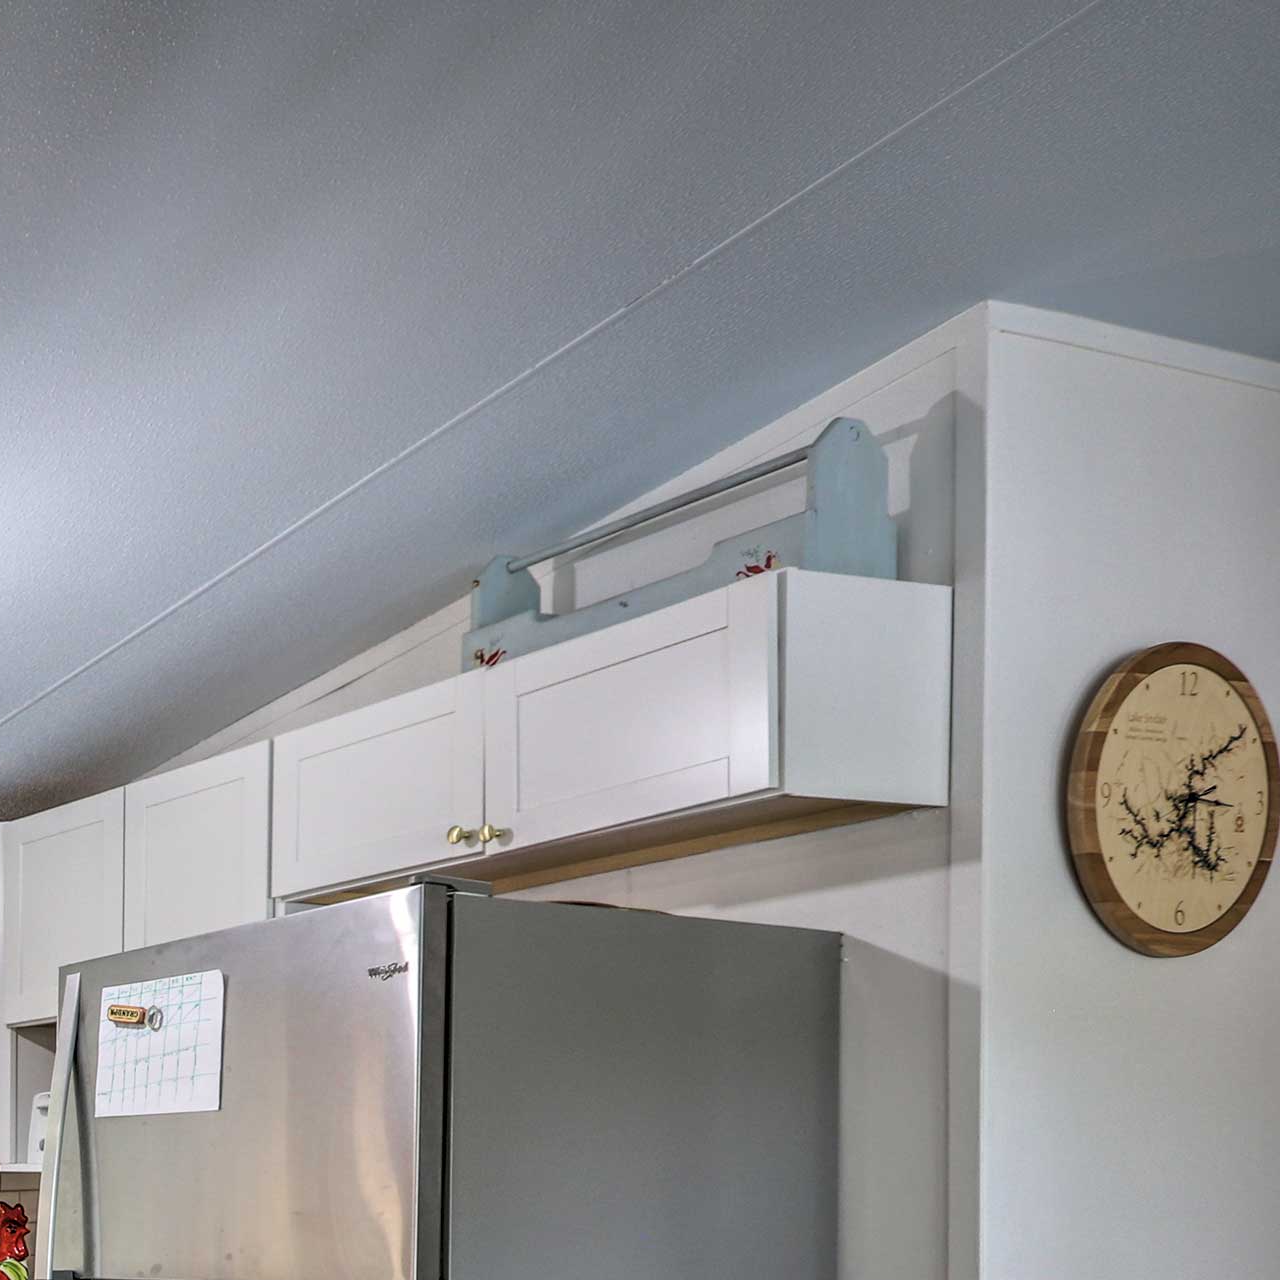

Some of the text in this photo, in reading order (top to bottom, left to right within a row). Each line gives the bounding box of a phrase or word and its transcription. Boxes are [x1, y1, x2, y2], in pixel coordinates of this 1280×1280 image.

[1179, 671, 1199, 697] 12
[1100, 782, 1112, 808] 9
[1255, 791, 1264, 816] 3
[1174, 900, 1186, 926] 6
